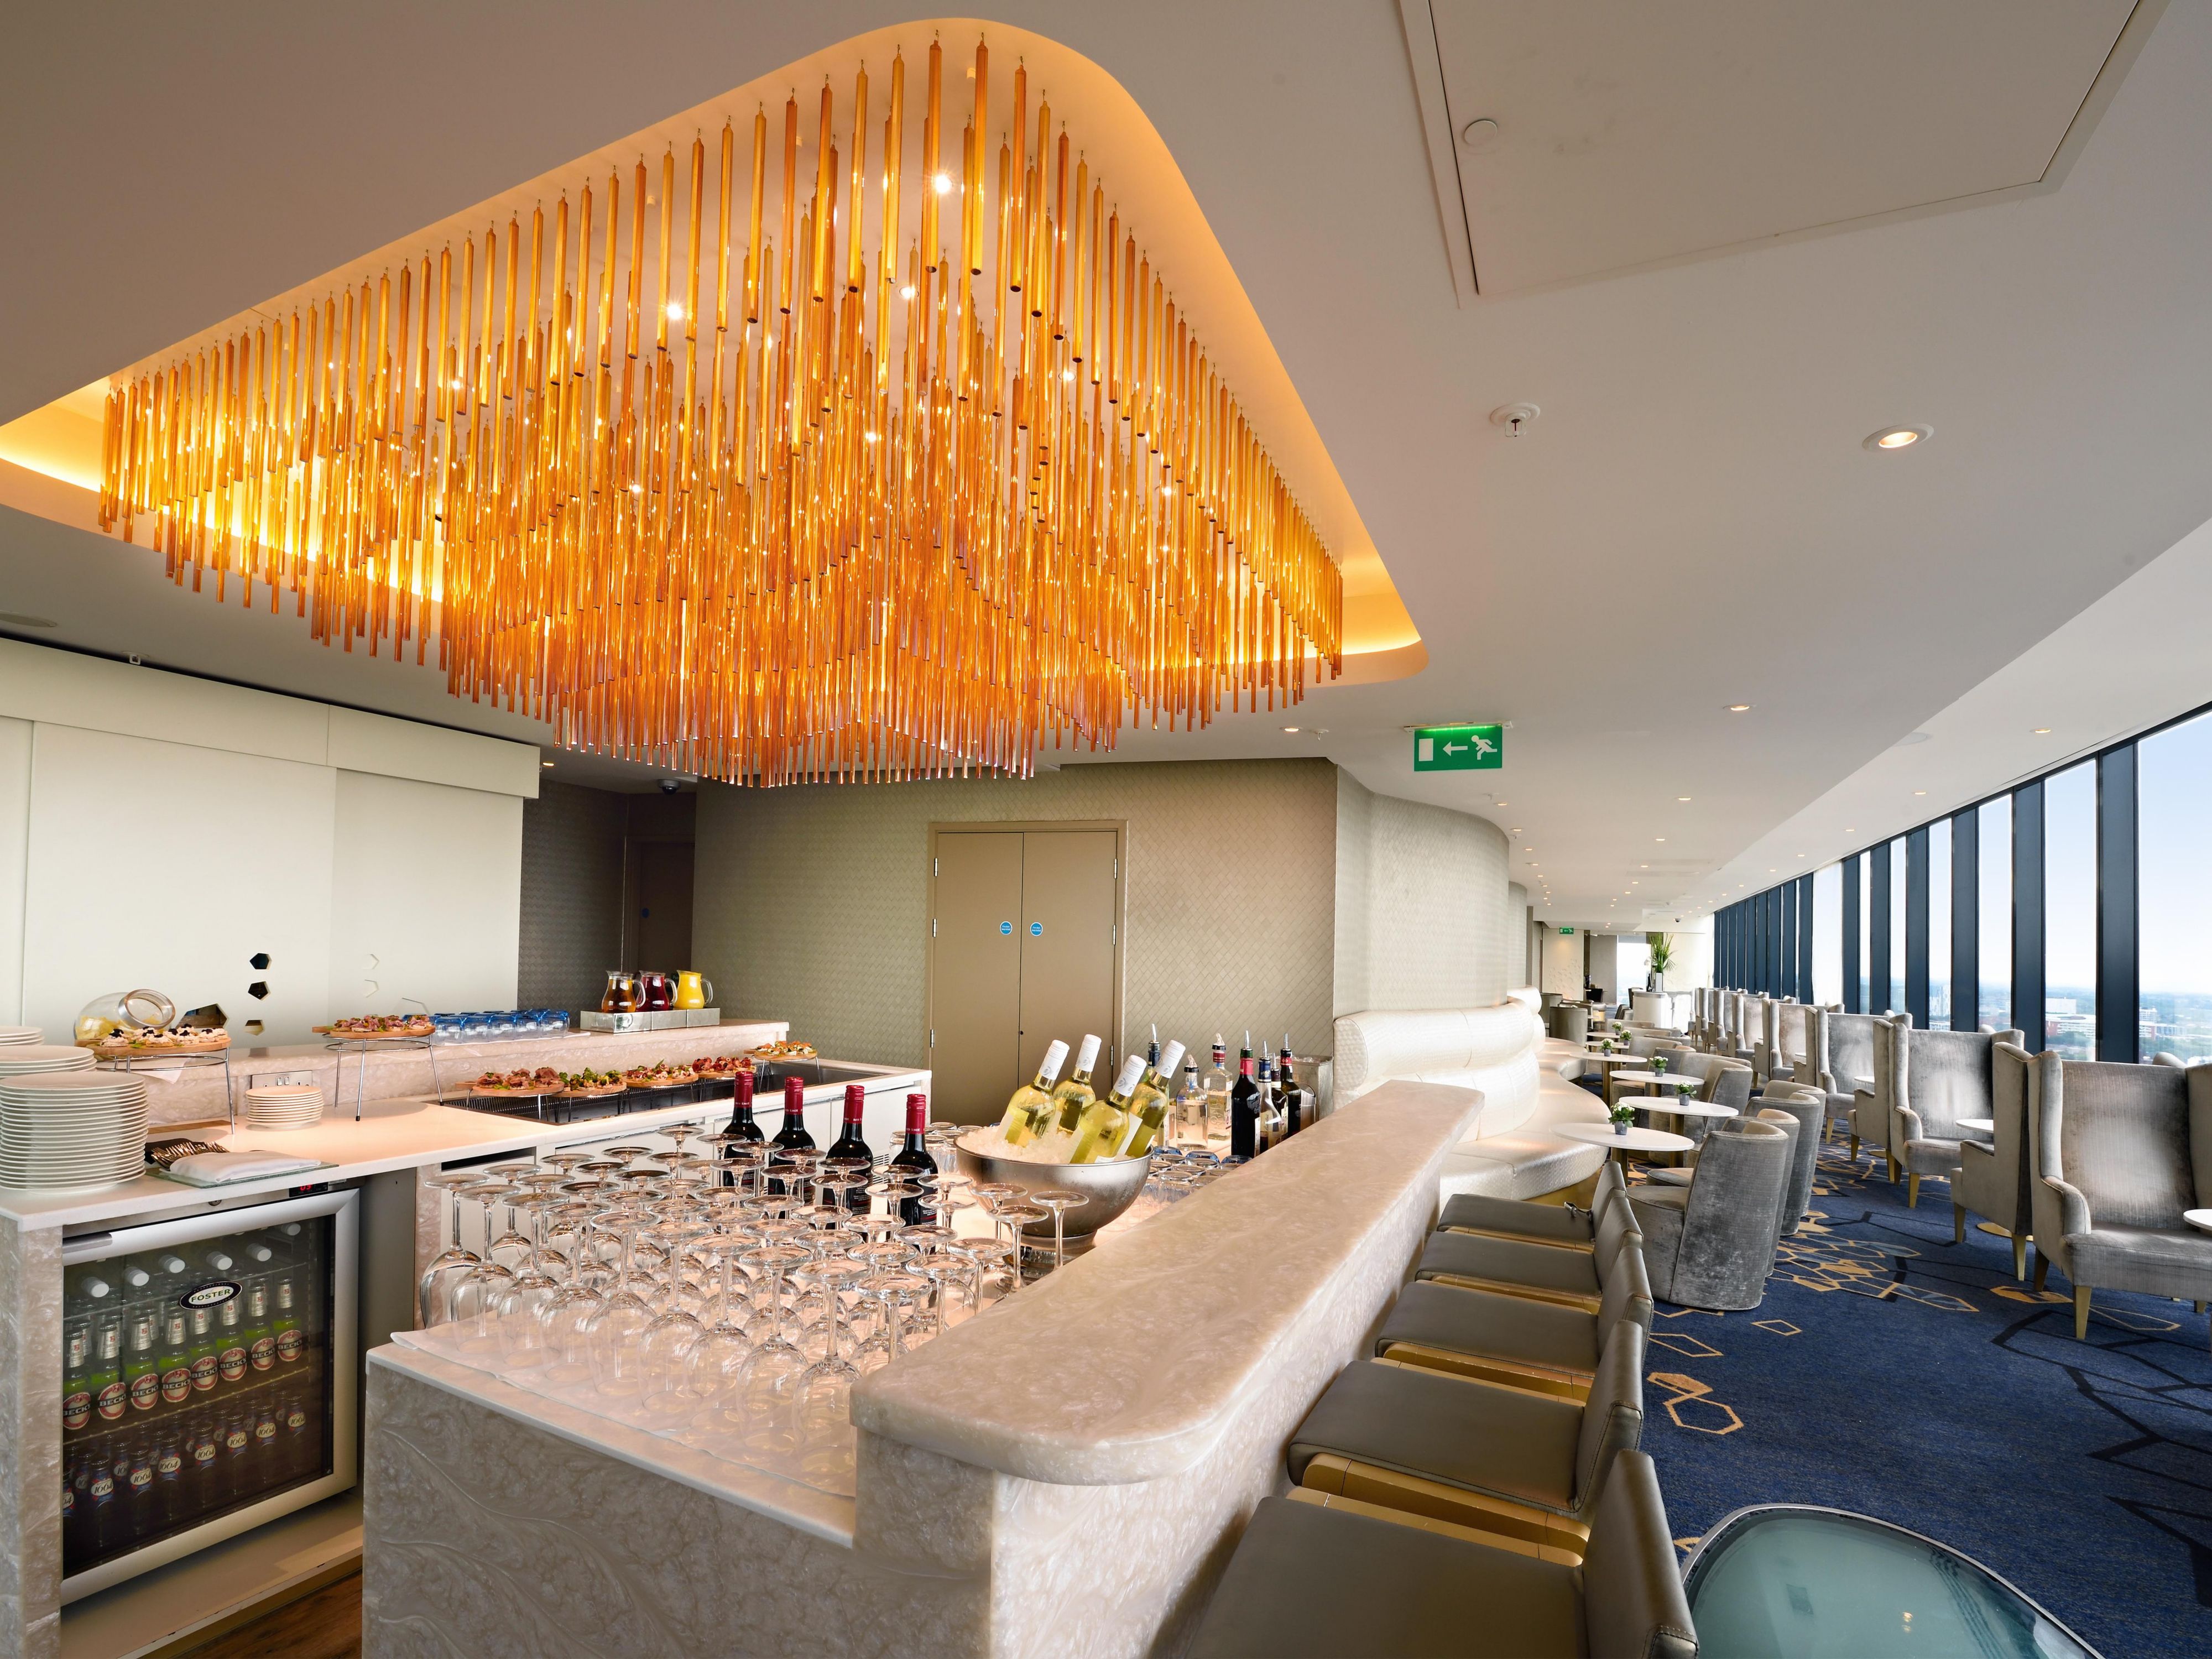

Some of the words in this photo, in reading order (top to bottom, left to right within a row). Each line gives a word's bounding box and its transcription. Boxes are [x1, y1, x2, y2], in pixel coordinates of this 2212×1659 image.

[191, 1289, 231, 1302] FOSTER
[197, 1448, 214, 1459] 1664
[94, 1483, 113, 1494] 1664
